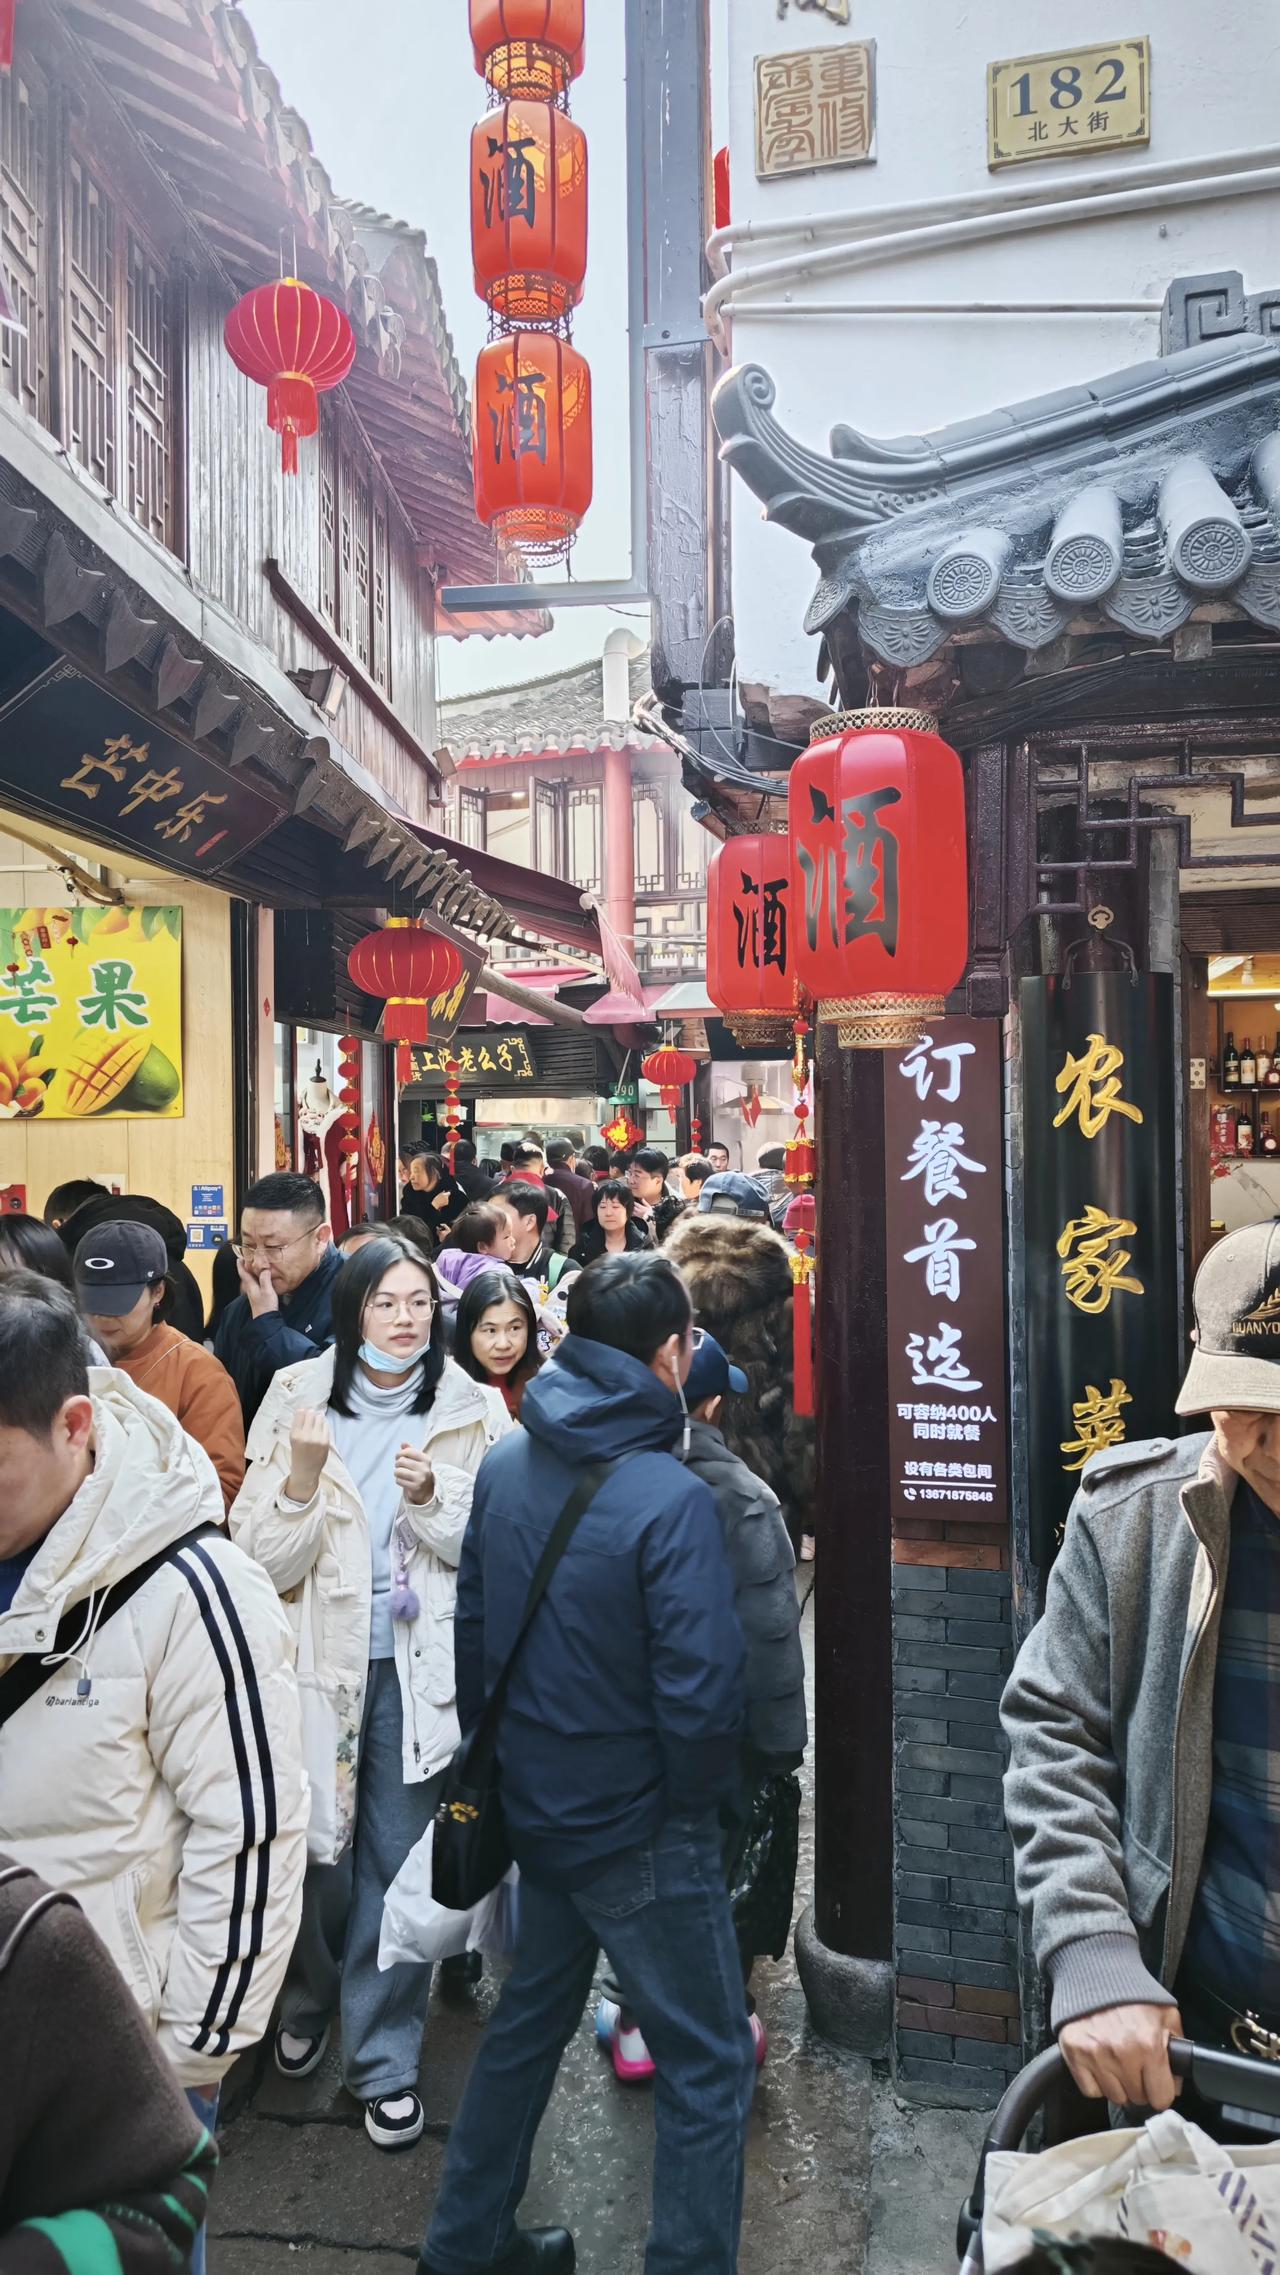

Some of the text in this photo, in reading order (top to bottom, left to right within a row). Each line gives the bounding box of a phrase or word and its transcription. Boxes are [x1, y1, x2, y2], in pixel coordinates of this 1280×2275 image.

[1010, 58, 1127, 118] 182
[1028, 111, 1110, 142] 北大街
[479, 135, 536, 229] 酒
[487, 370, 547, 465] 酒
[797, 784, 902, 957] 酒
[733, 869, 789, 976] 酒
[0, 959, 149, 1030] 芒果
[899, 1035, 987, 1393] 订餐首选
[1052, 1033, 1144, 1546] 农家菜
[896, 1403, 998, 1422] 可容纳400人
[913, 1422, 981, 1441] 同时就餐
[904, 1461, 993, 1479] 设有各类包间
